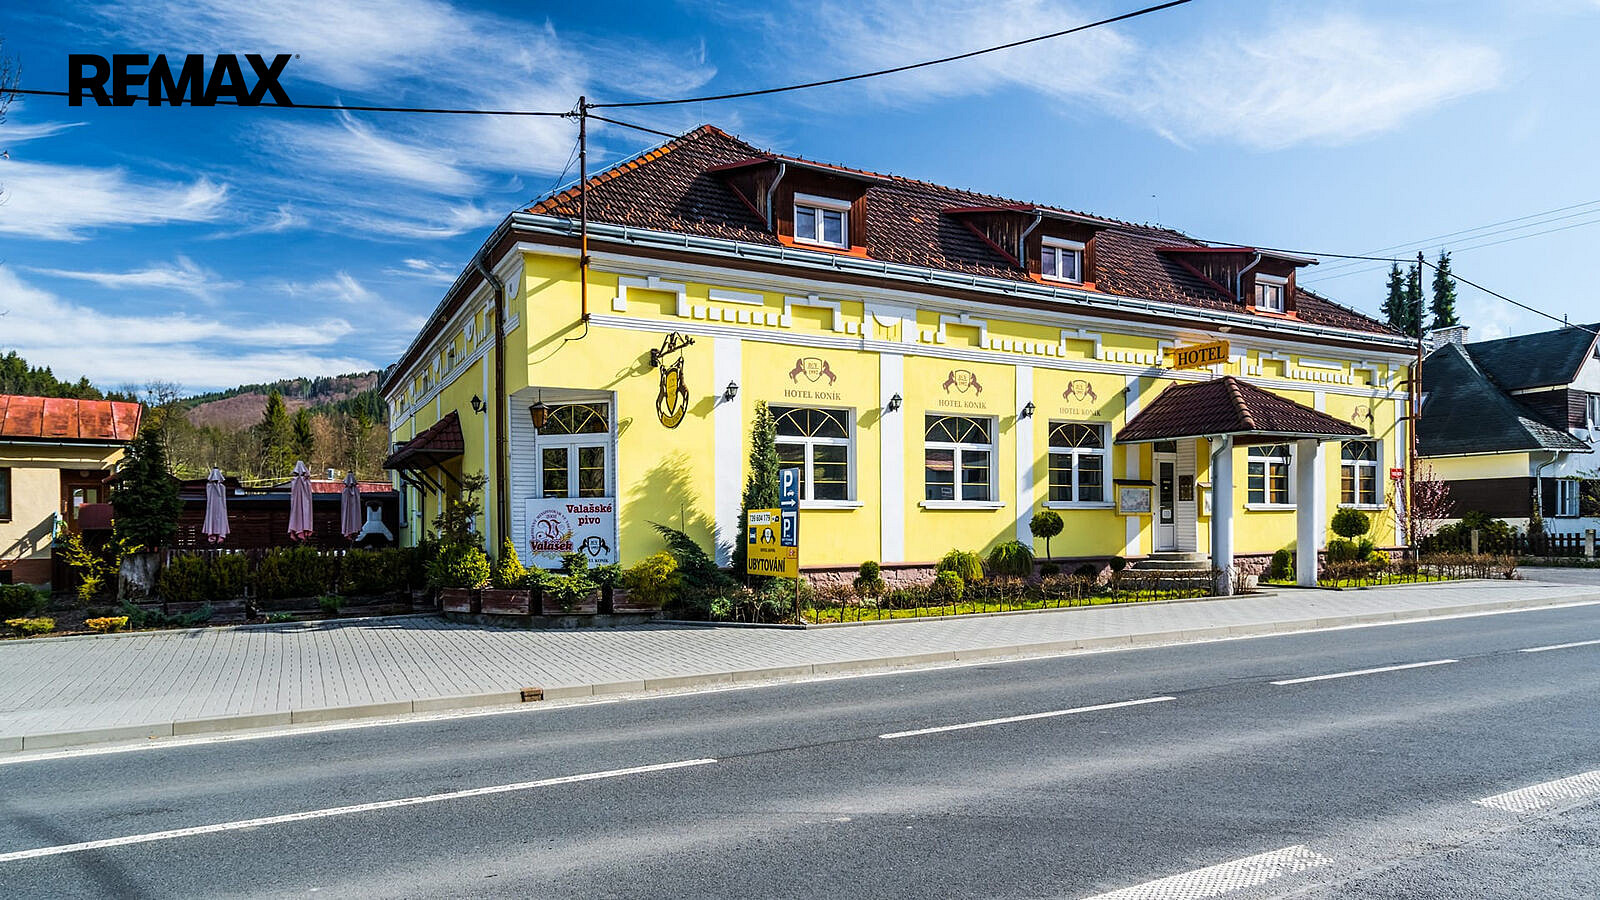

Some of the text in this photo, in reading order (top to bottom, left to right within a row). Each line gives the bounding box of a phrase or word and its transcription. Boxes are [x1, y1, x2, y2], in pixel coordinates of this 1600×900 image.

[1178, 346, 1225, 366] HOTEL
[784, 389, 813, 398] HOTEL
[938, 399, 962, 407] HOTEL
[1059, 407, 1080, 415] HOTEL
[783, 470, 793, 497] P
[566, 503, 612, 514] Valašské
[578, 515, 601, 527] pivo
[783, 518, 791, 538] P
[748, 557, 786, 573] UBYTOVÁNÍ
